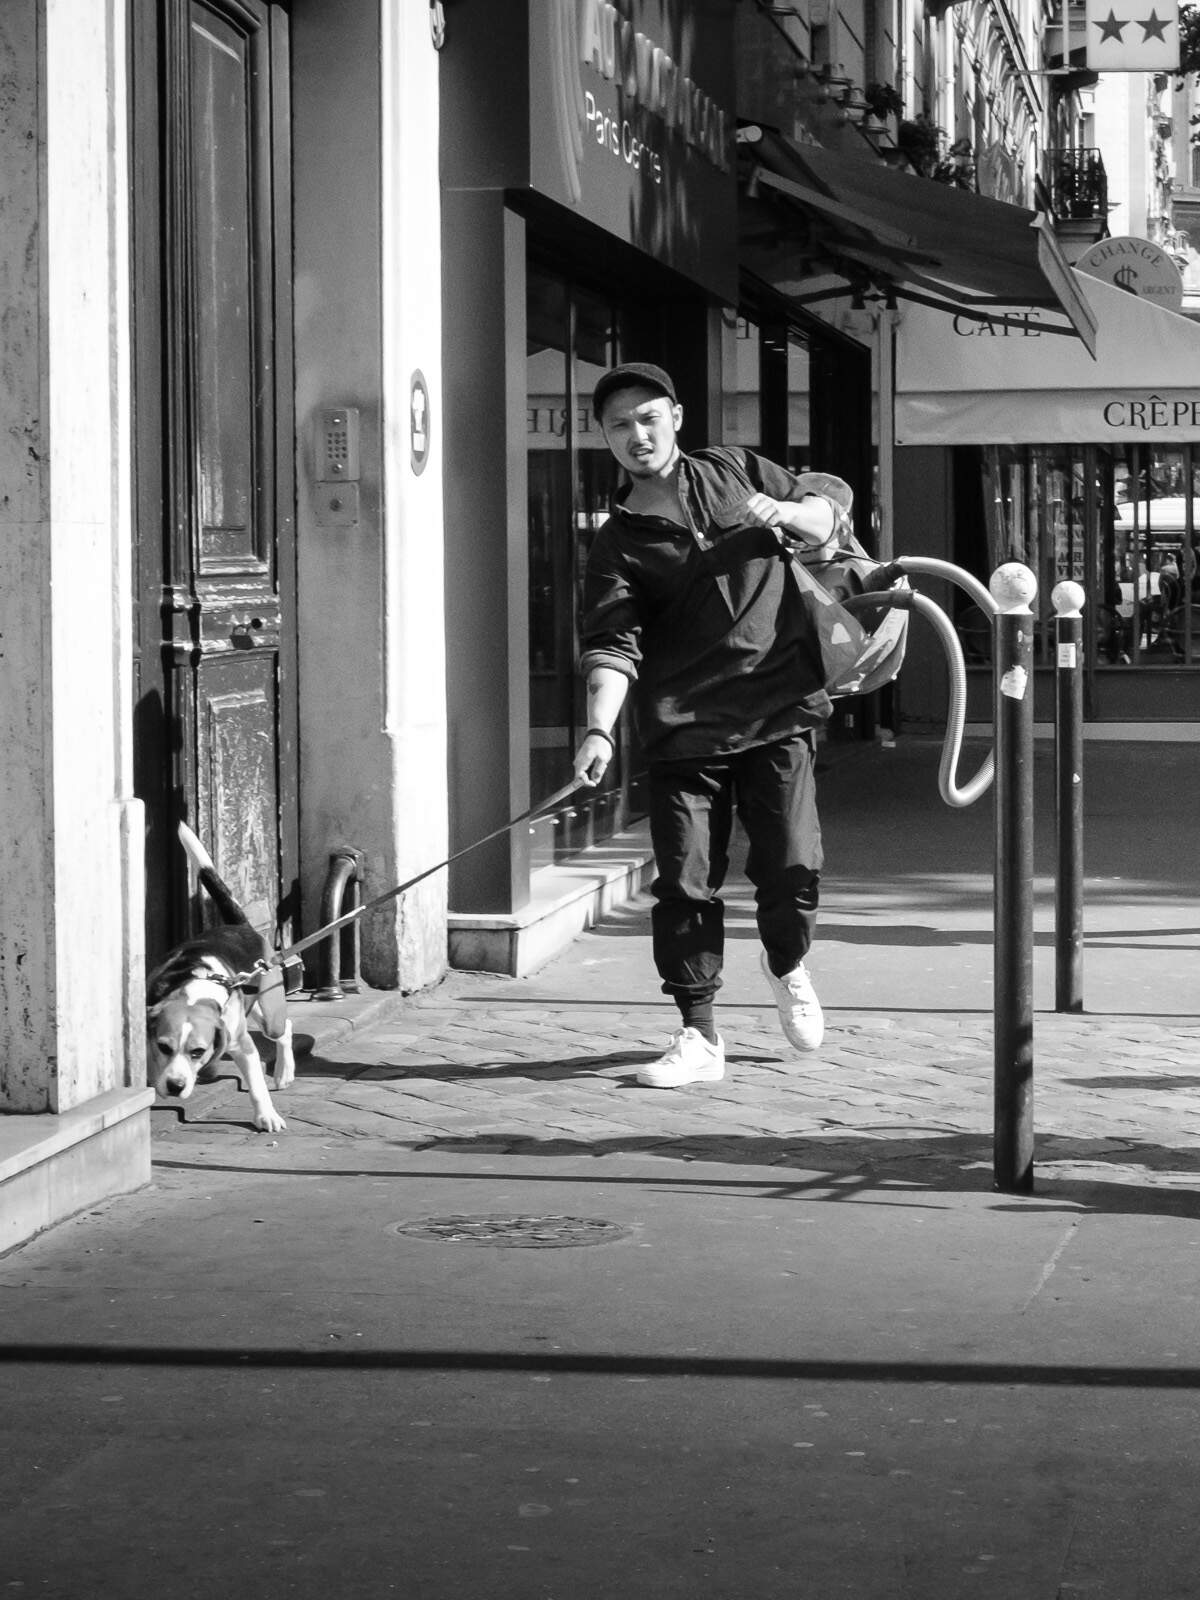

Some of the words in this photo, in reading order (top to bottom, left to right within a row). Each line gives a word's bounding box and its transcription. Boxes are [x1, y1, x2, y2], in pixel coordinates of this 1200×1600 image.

[584, 89, 620, 156] Paris
[1089, 241, 1164, 268] CHANGE
[952, 306, 1041, 337] CAFÉ
